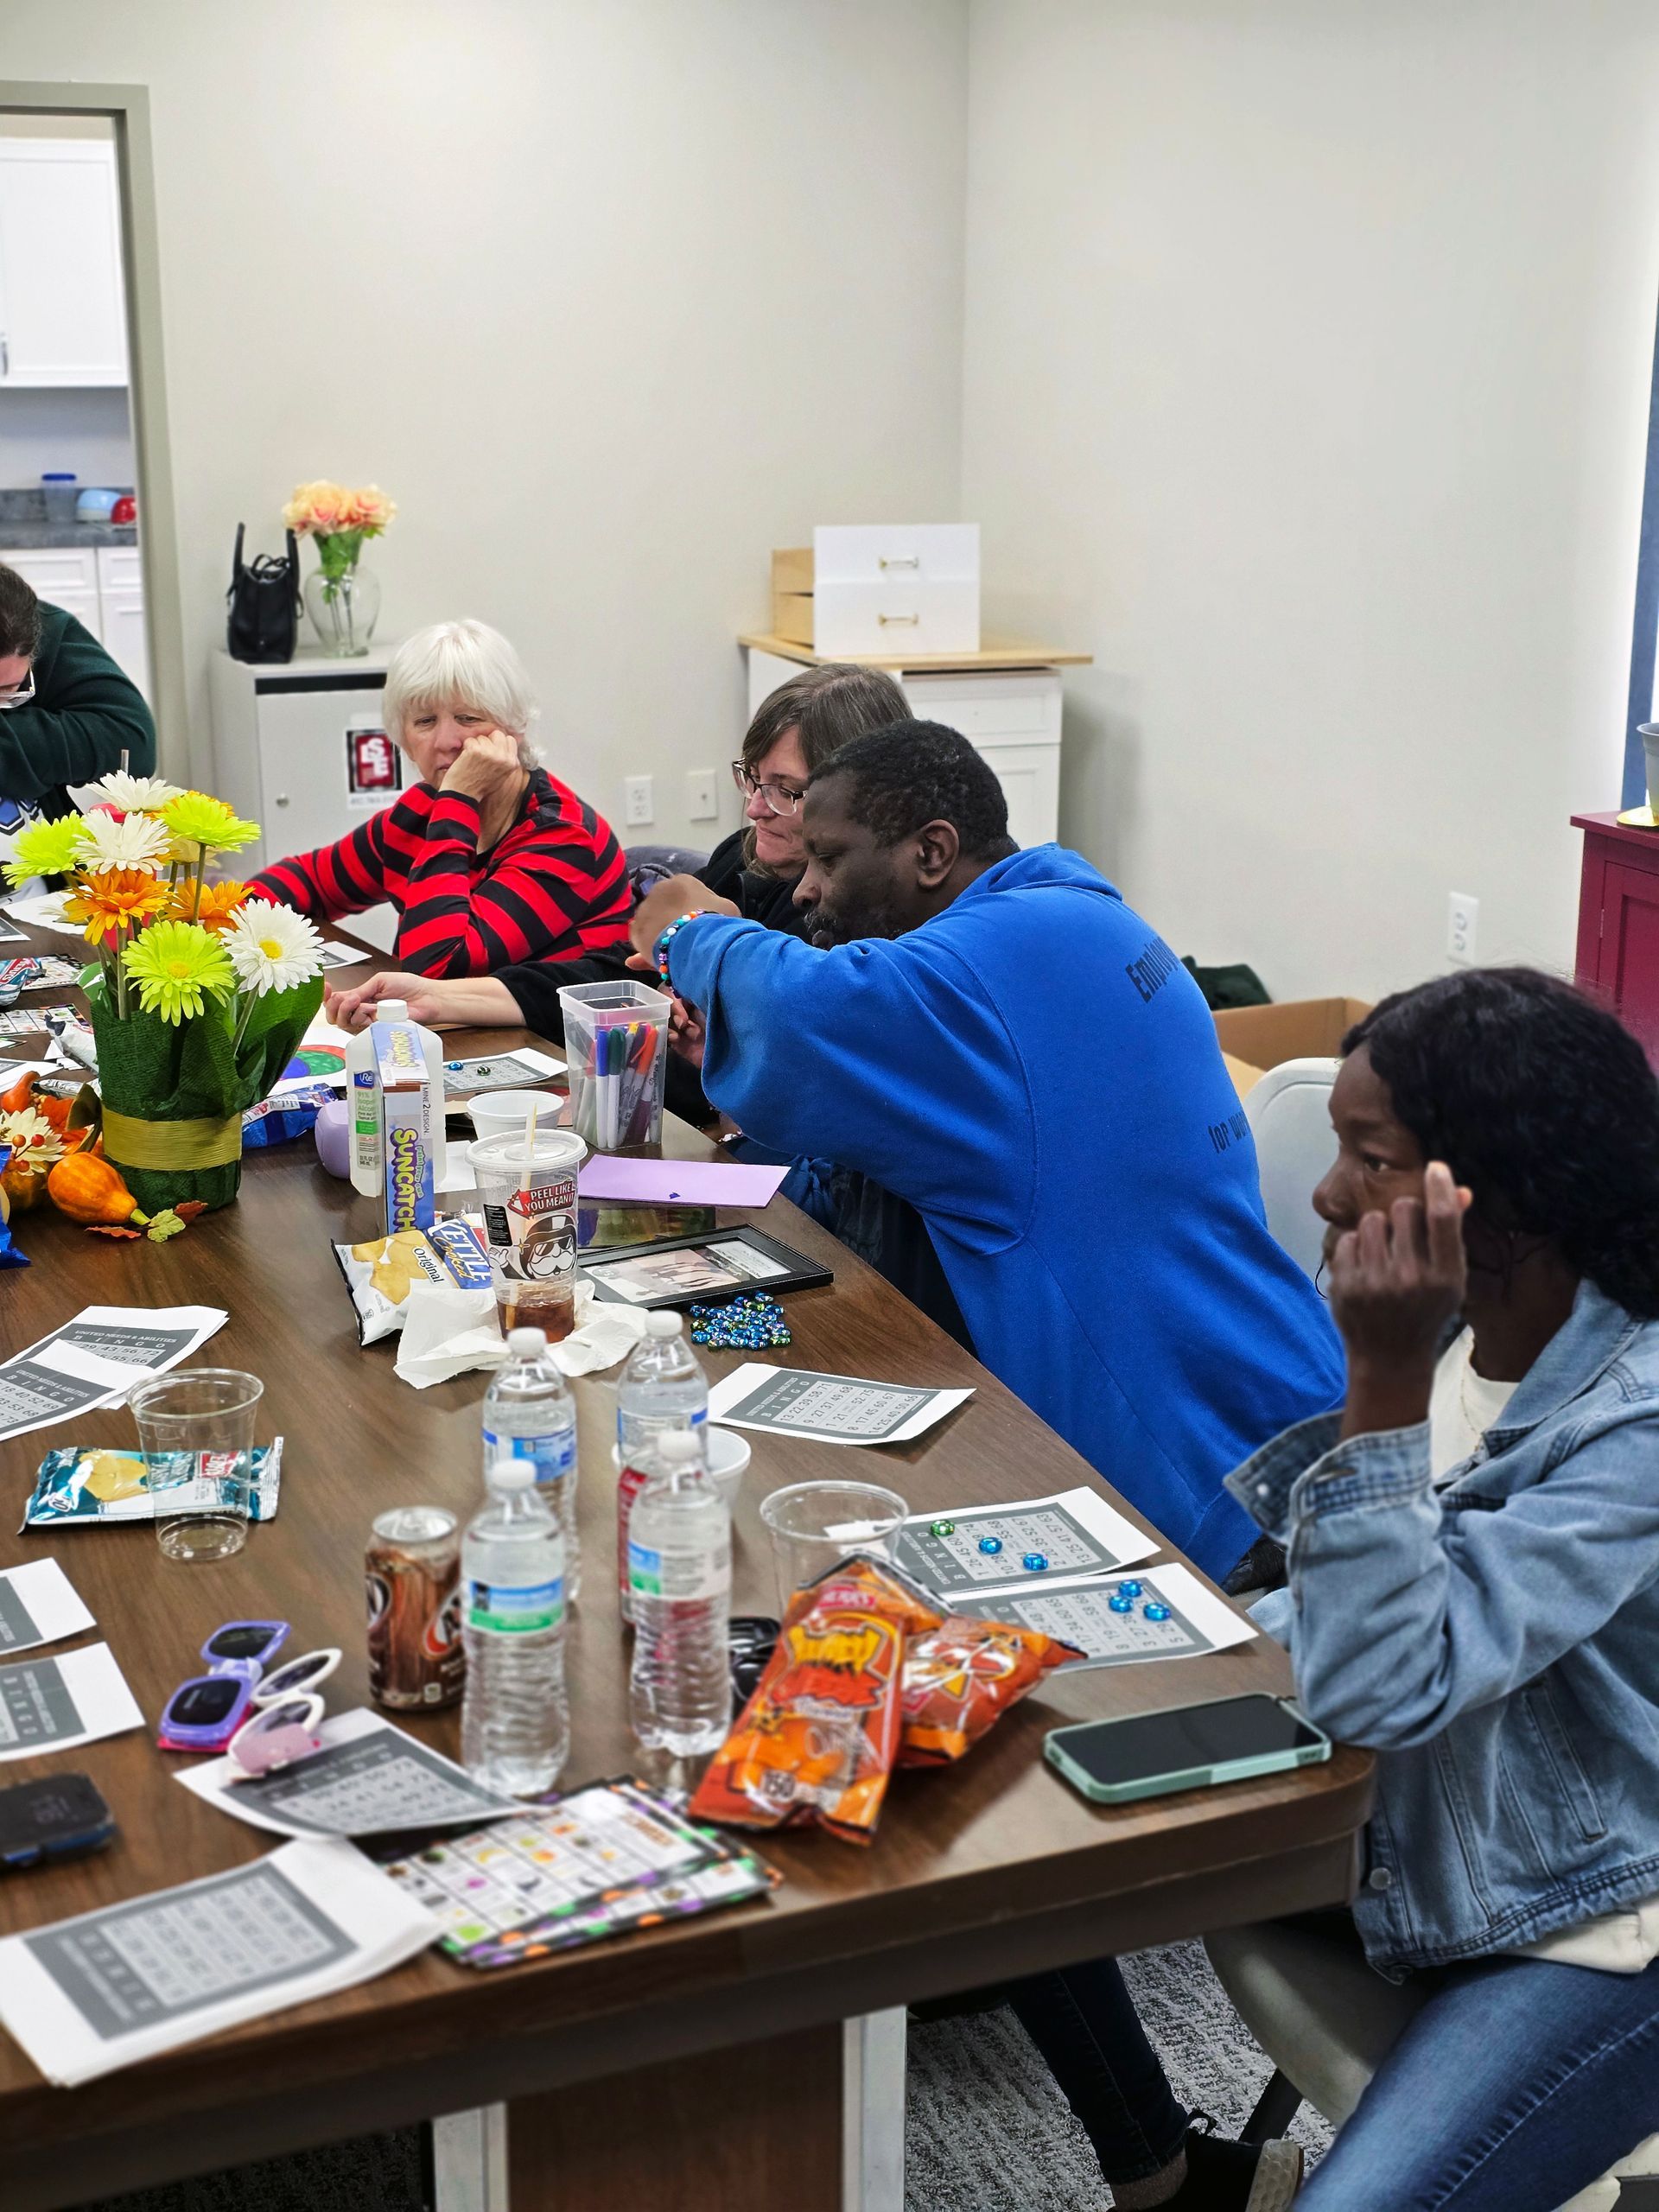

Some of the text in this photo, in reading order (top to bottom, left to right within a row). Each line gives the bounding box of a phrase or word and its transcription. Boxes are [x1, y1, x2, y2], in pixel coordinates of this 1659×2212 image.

[416, 1146, 425, 1165] paint
[415, 1183, 423, 1198] own
[531, 1183, 572, 1201] PEEL LIKE
[524, 1200, 544, 1211] YOU
[546, 1194, 569, 1208] MEAN
[428, 1218, 492, 1281] KETTLE
[414, 1248, 445, 1283] Original
